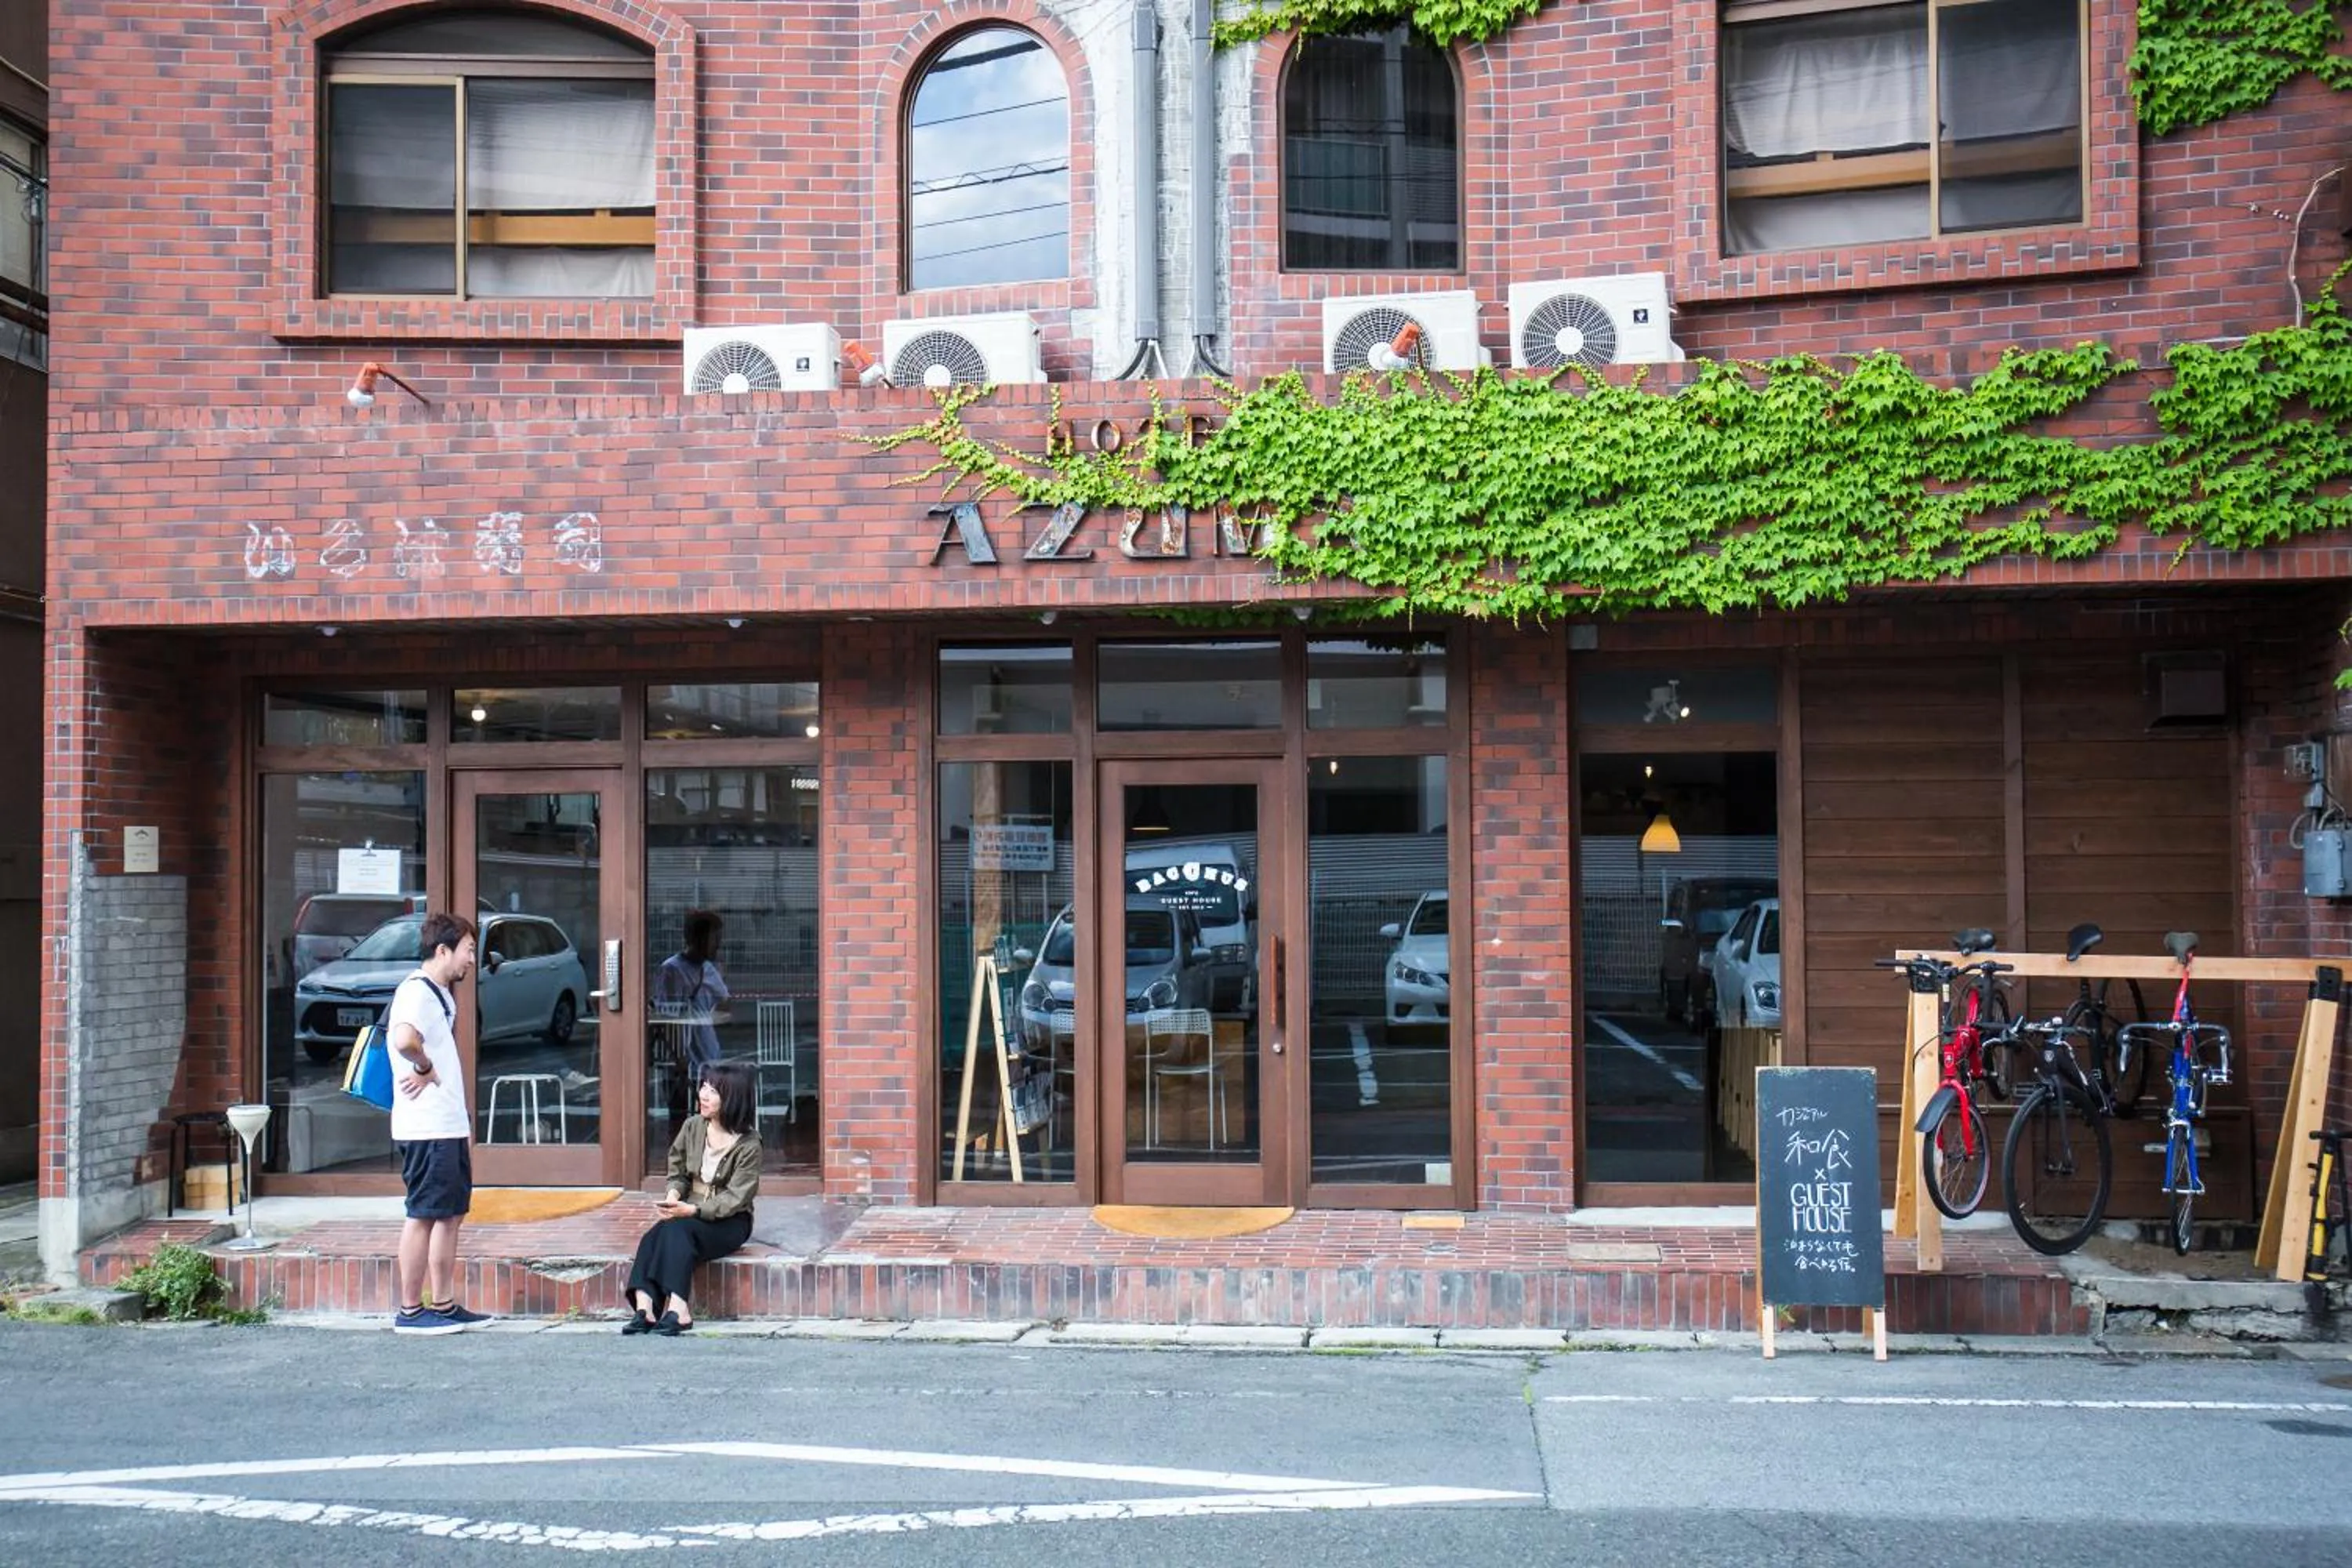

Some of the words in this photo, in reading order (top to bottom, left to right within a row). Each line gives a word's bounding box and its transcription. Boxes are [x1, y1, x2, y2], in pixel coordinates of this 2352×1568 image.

[927, 499, 1358, 567] AZUM
[1784, 1129, 1853, 1169] 和食
[1790, 1181, 1853, 1207] GUEST
[1791, 1207, 1853, 1233] HOUSE
